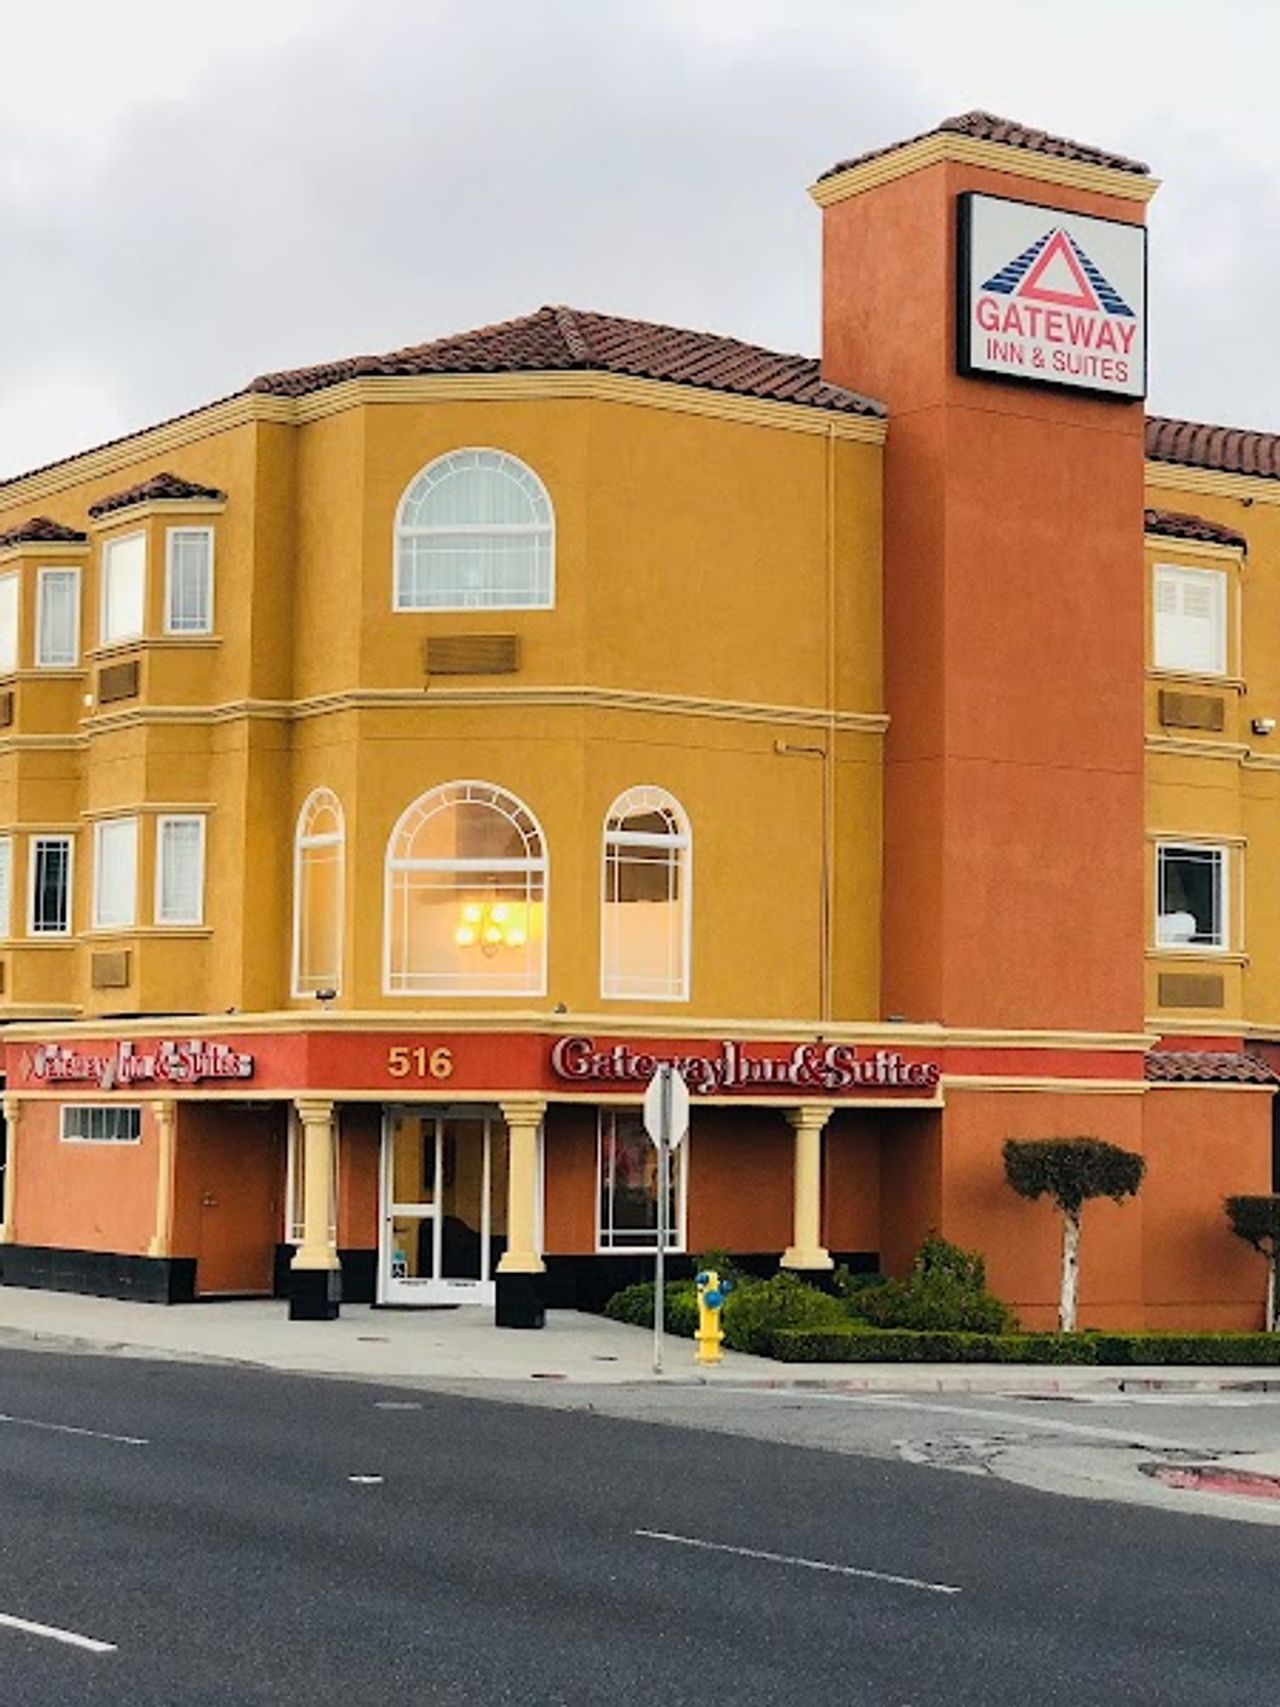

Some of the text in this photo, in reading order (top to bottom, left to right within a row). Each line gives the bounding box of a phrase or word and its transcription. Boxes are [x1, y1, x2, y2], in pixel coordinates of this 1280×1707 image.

[976, 296, 1136, 354] GATEWAY
[986, 338, 1129, 382] INN & SUITES
[387, 1047, 453, 1078] 516
